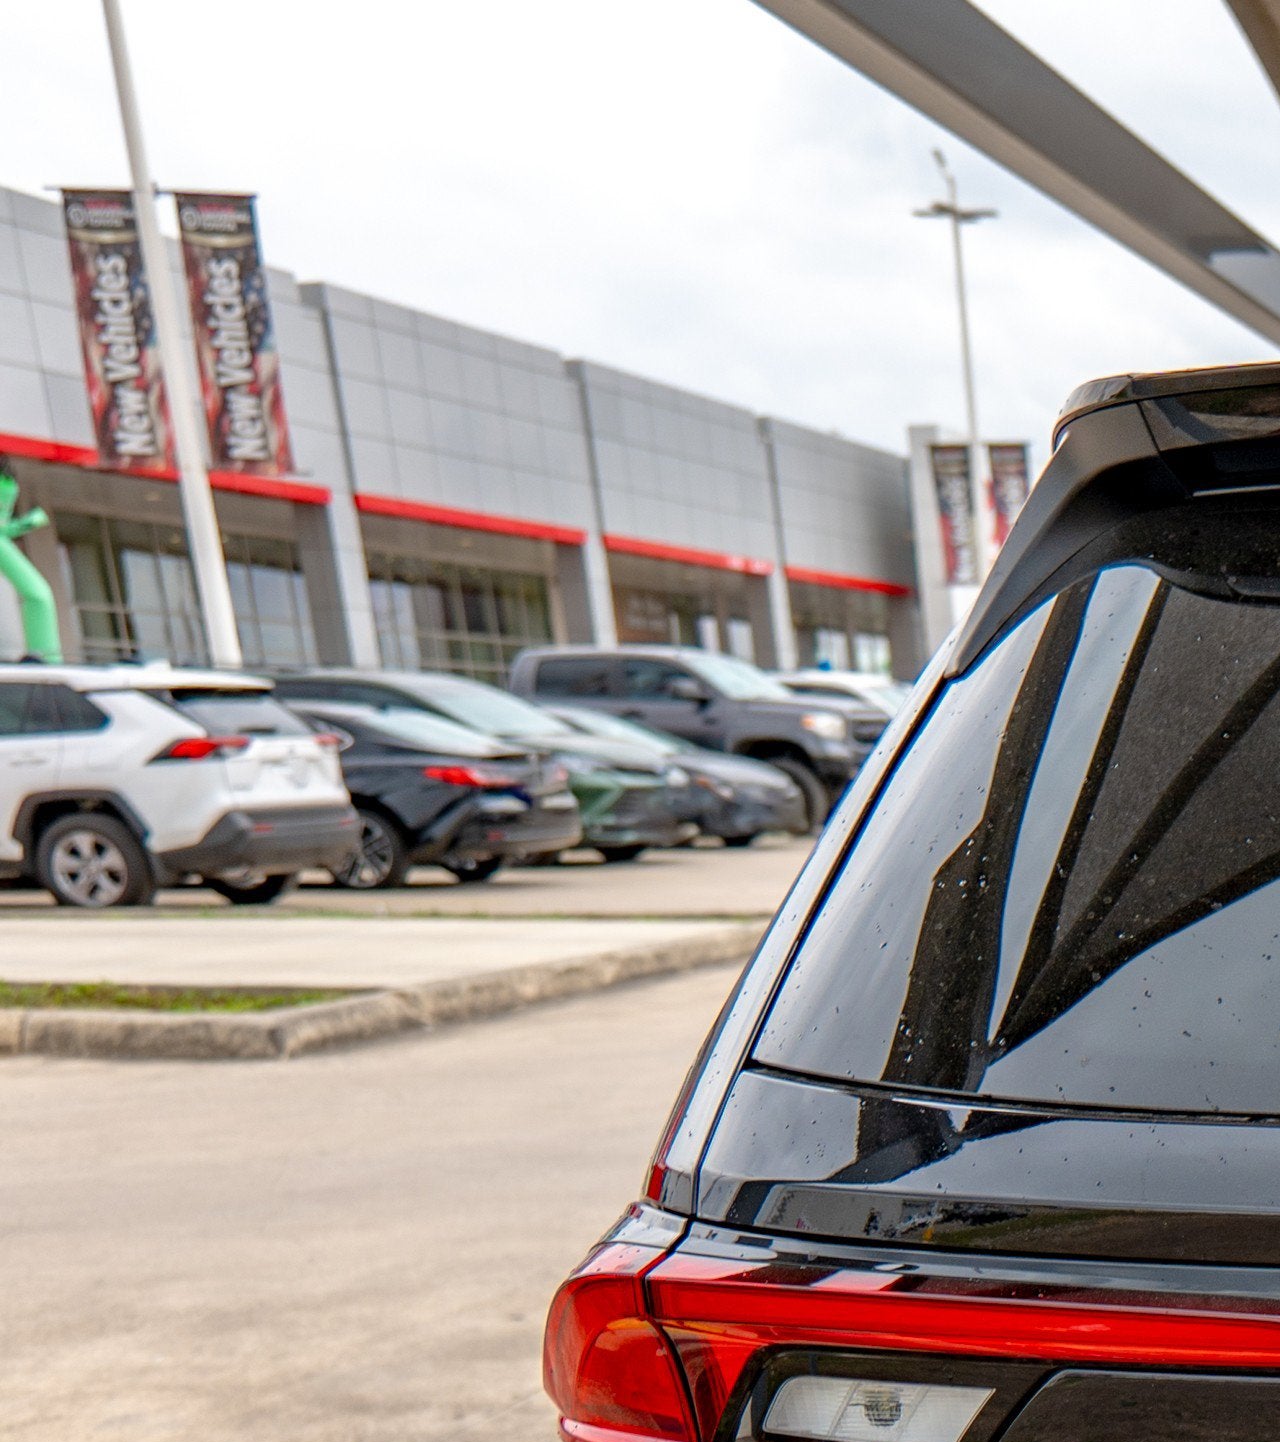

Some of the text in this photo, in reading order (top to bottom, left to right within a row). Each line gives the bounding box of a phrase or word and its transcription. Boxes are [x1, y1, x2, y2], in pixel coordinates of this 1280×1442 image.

[91, 254, 142, 383] Vehicles
[203, 256, 256, 387] Vehicles
[114, 382, 156, 456] New
[225, 387, 271, 460] New
